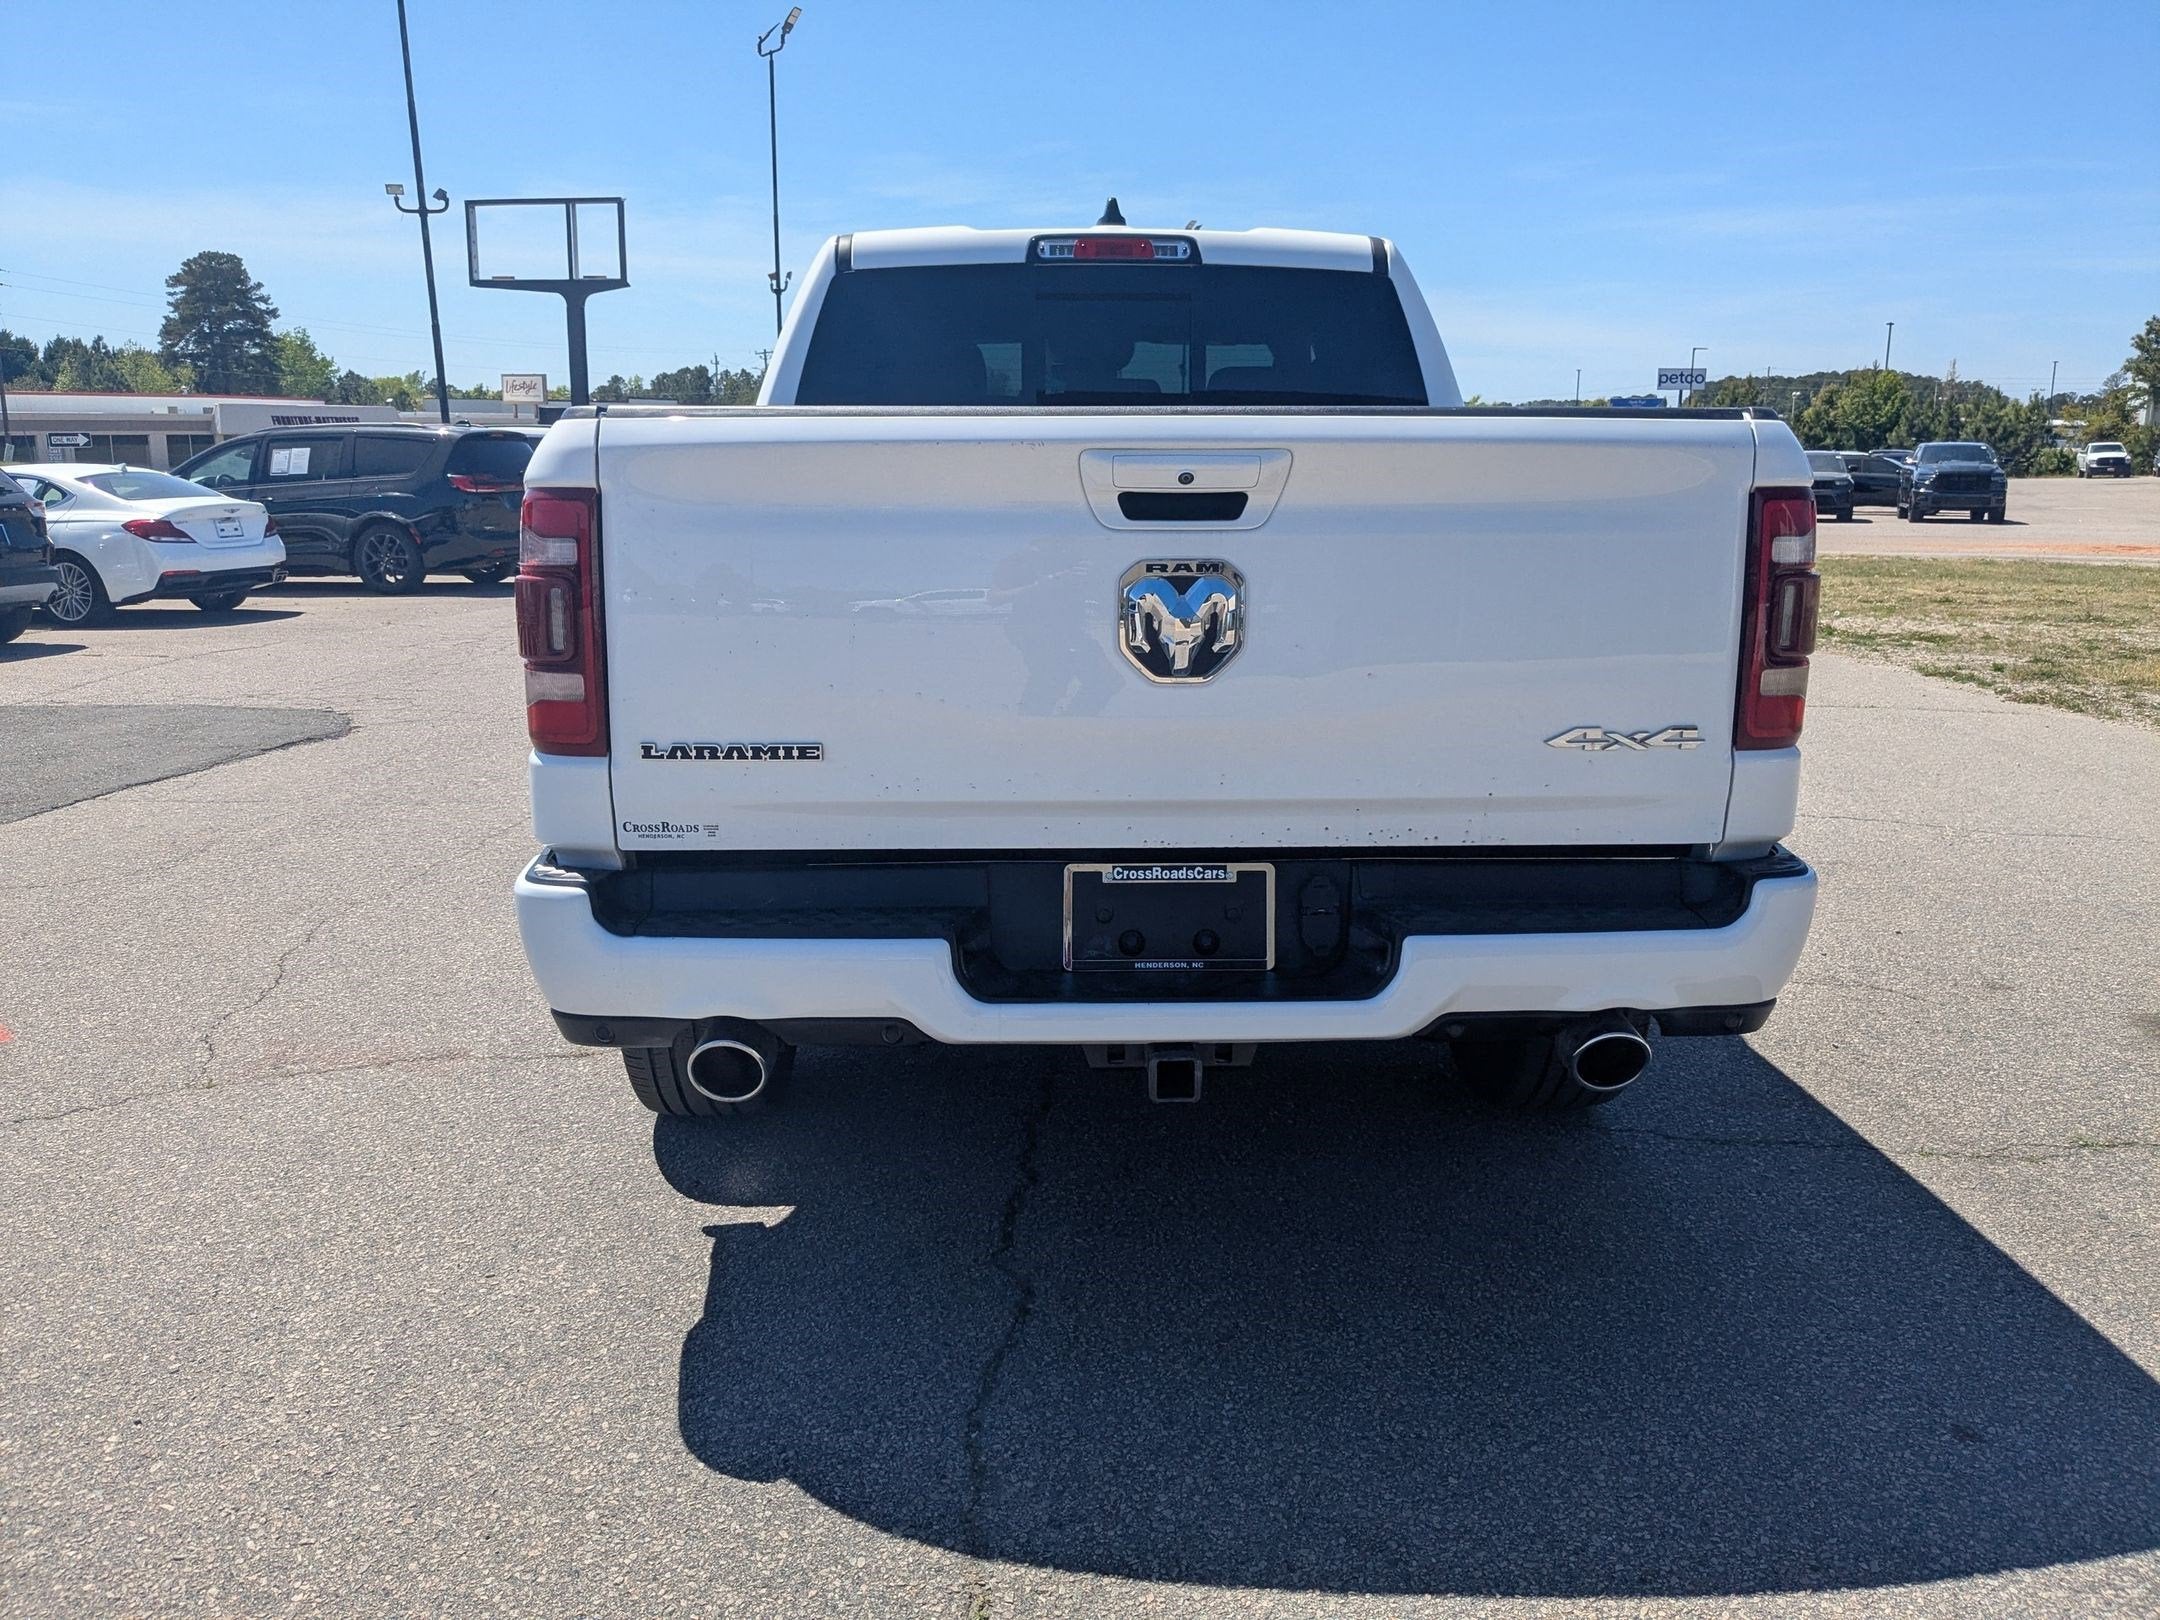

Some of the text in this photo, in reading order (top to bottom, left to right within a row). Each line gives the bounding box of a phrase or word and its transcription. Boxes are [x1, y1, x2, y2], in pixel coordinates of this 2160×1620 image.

[1658, 371, 1705, 387] petco
[1145, 562, 1221, 574] RAM
[640, 743, 823, 761] LARAMIE
[1113, 867, 1226, 881] CrossRoadsCars
[1134, 961, 1204, 970] HENDERSON, NC
